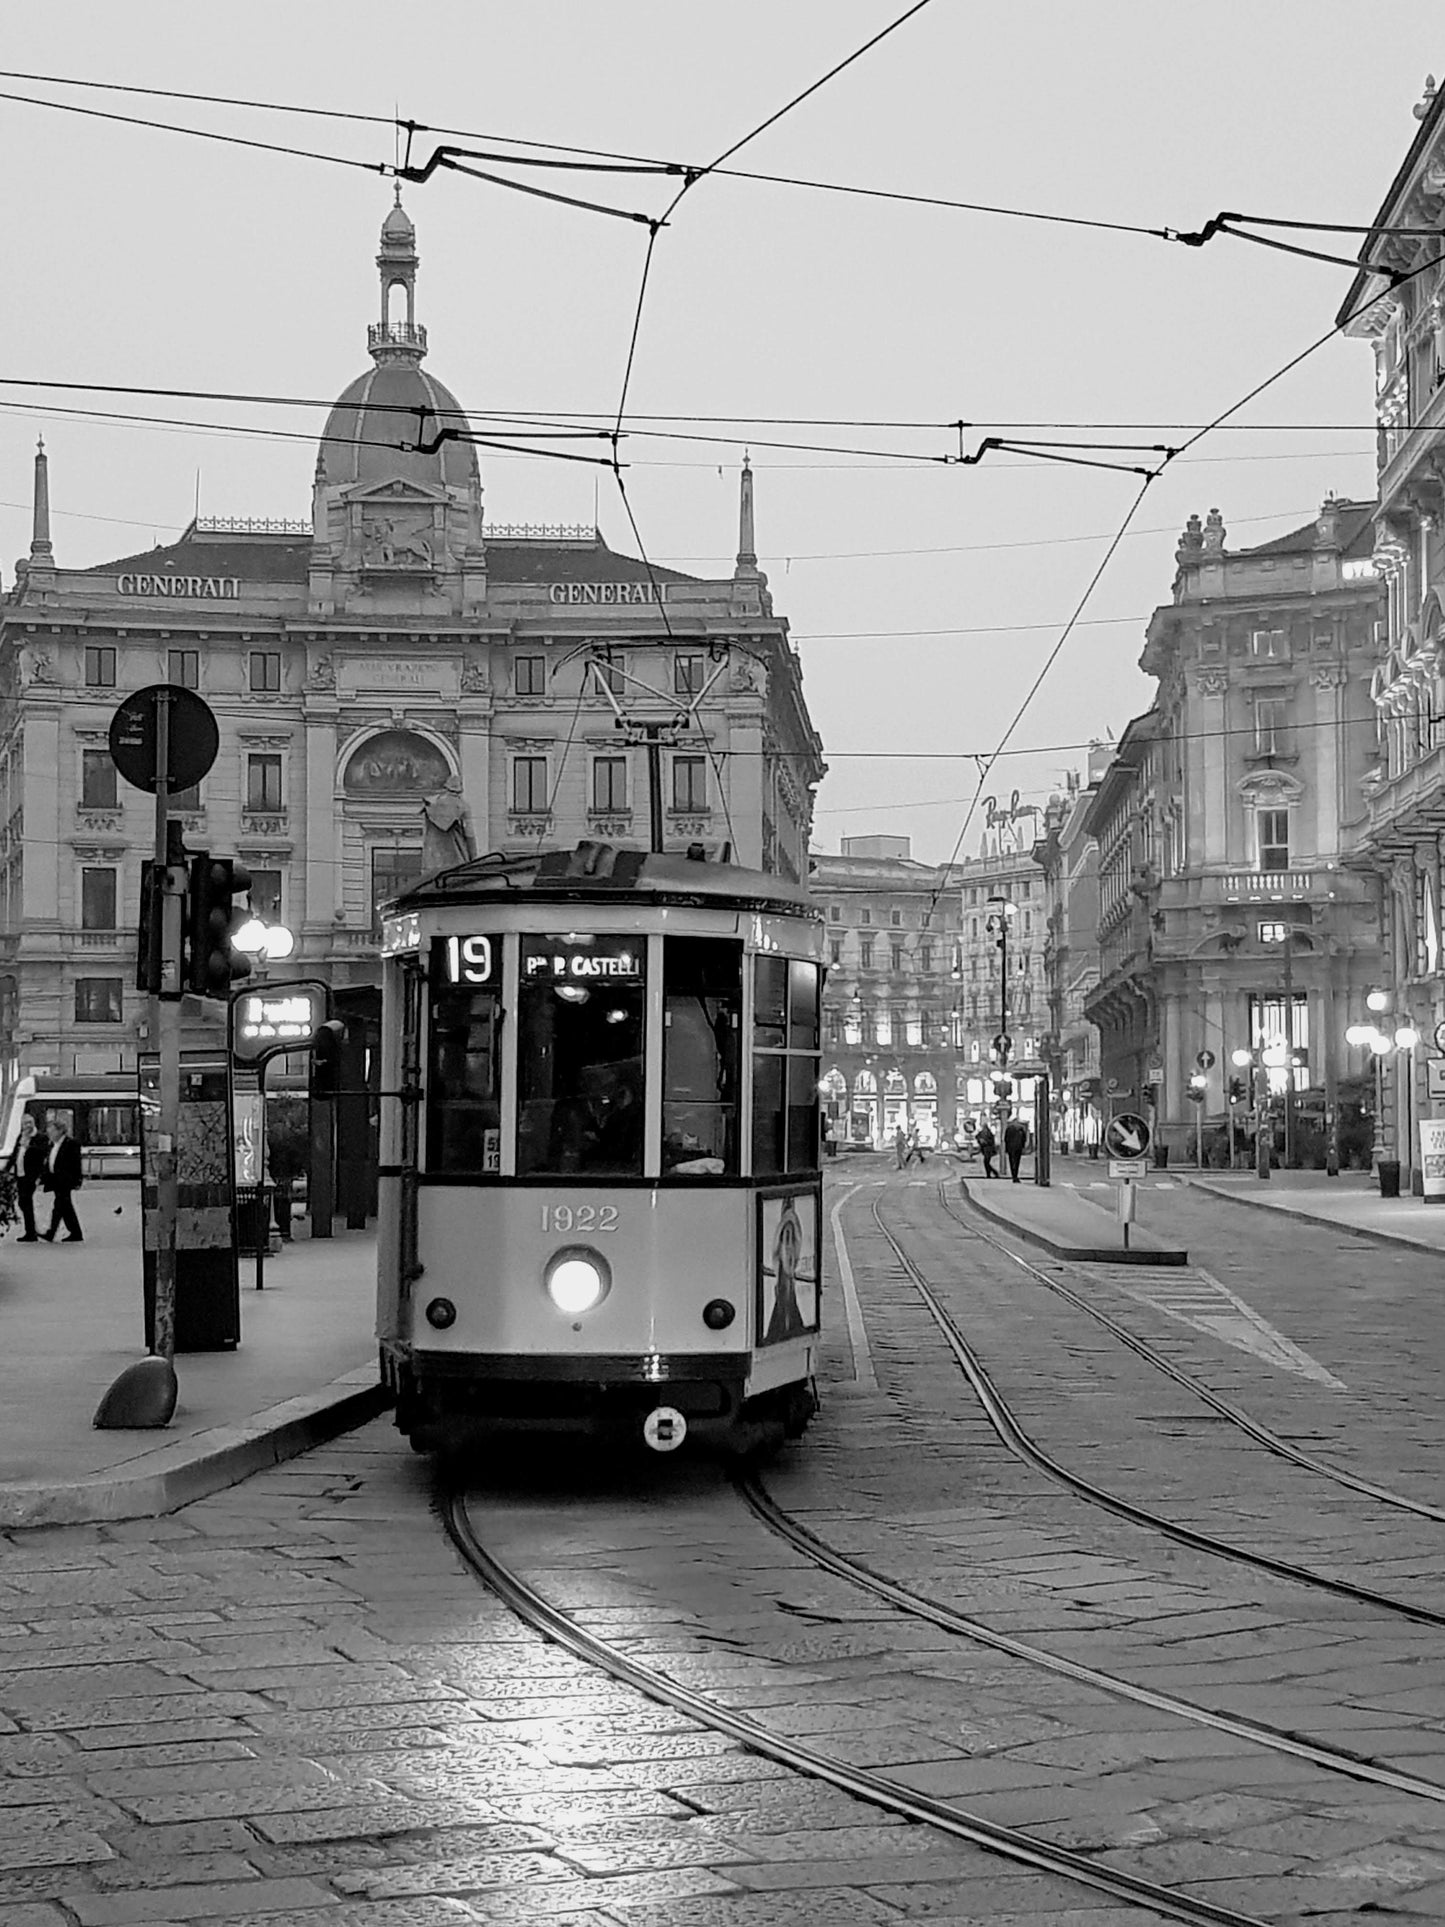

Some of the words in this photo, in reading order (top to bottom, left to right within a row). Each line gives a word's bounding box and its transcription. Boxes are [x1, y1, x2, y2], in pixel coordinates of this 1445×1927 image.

[117, 573, 240, 598] GENERALI
[549, 582, 669, 604] GENERALI
[448, 936, 491, 983] 19
[571, 955, 639, 976] CASTELLI
[542, 1206, 619, 1231] 1922
